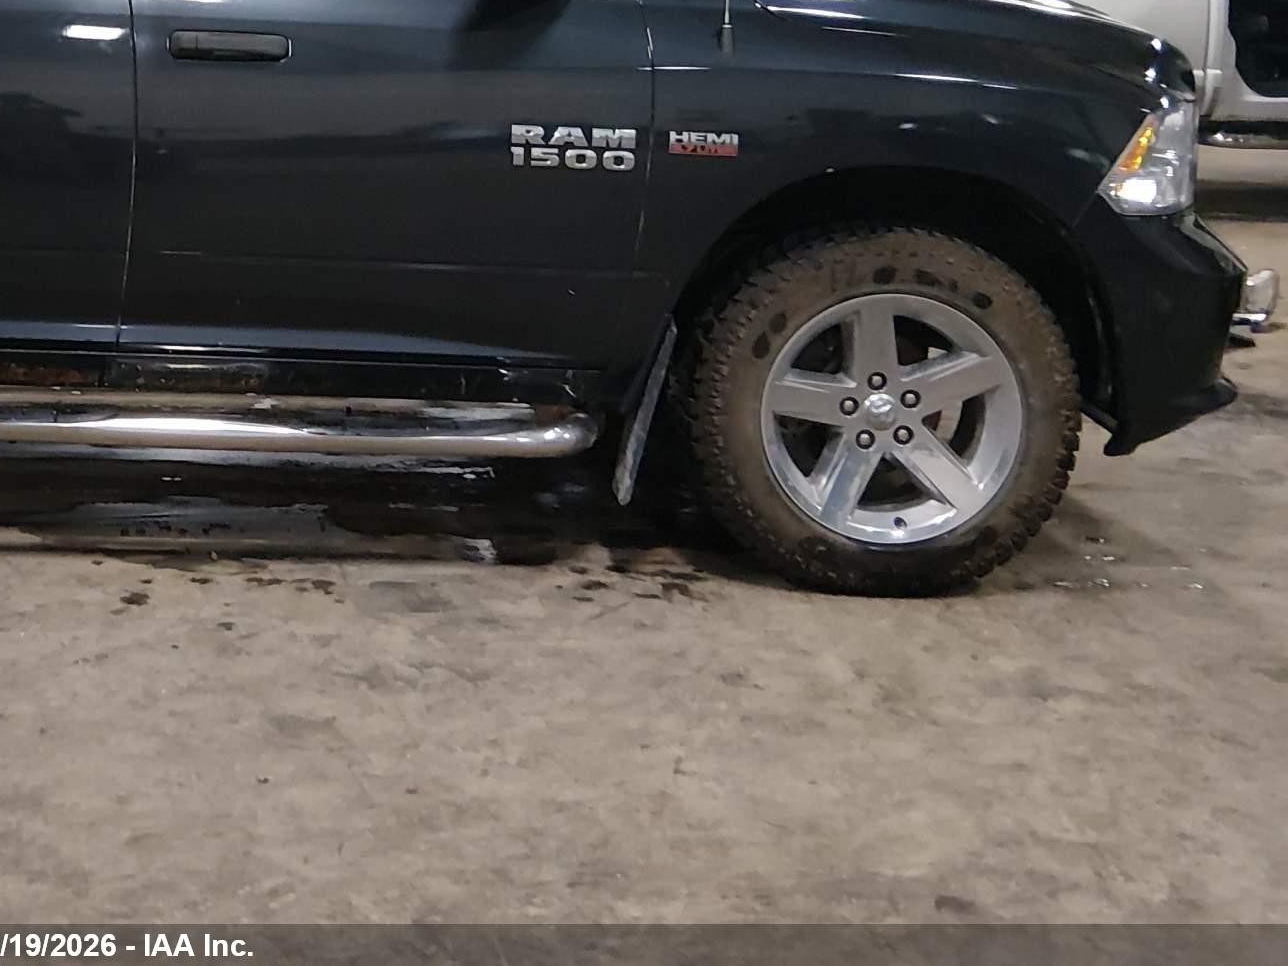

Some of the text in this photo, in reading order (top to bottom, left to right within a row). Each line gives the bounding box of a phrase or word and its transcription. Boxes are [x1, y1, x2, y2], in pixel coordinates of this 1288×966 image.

[511, 124, 637, 149] RAM
[669, 131, 739, 145] HEMI
[510, 146, 635, 172] 1500
